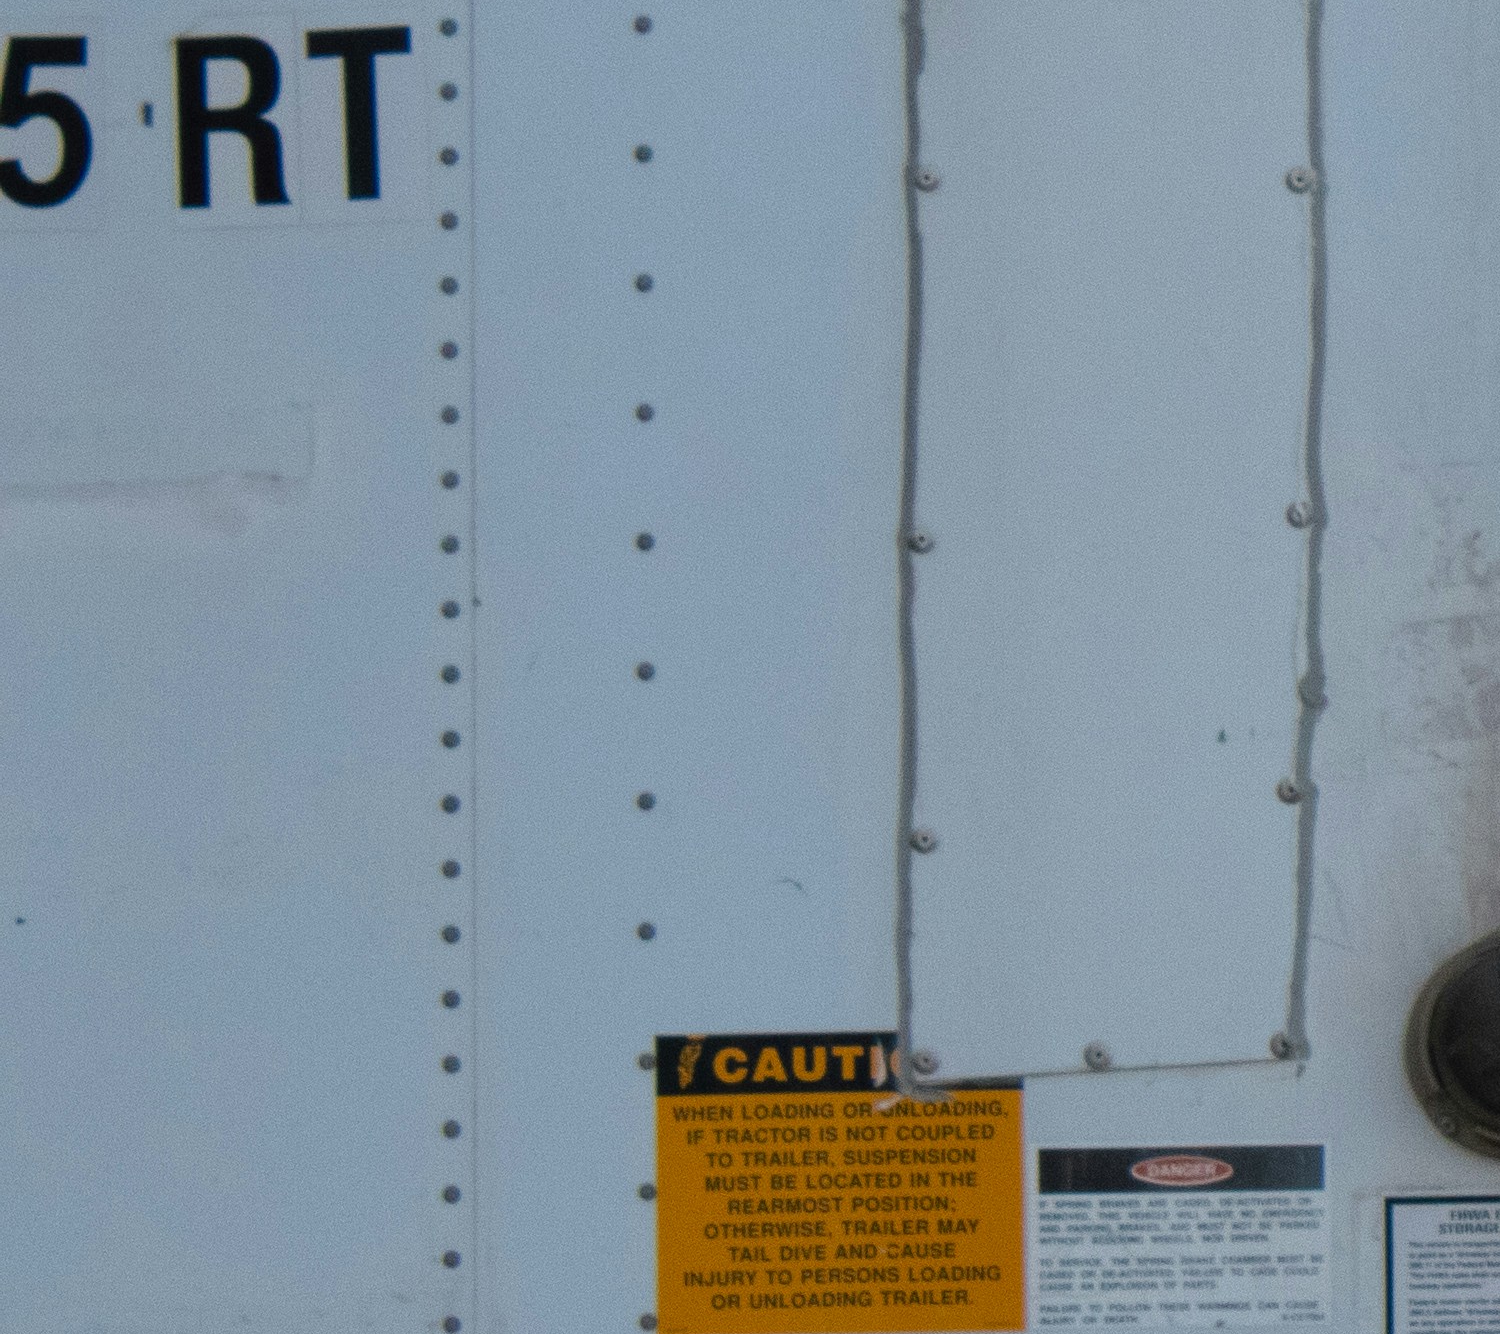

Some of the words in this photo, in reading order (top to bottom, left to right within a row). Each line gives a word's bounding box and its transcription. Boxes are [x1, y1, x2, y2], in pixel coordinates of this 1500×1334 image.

[0, 34, 93, 208] 5
[173, 25, 412, 209] RT
[712, 1045, 901, 1084] CAUTI
[673, 1105, 734, 1122] WHEN
[742, 1103, 834, 1120] LOADING
[843, 1102, 873, 1118] OR
[687, 1129, 704, 1145] IF
[714, 1127, 811, 1144] TRACTOR
[820, 1127, 838, 1142] IS
[846, 1125, 888, 1141] NOT
[896, 1124, 995, 1140] COUPLED
[706, 1152, 733, 1167] TO
[742, 1150, 834, 1167] TRAILER,
[843, 1148, 977, 1165] SUSPENSION
[705, 1176, 760, 1192] MUST
[771, 1175, 796, 1190] BE
[806, 1173, 901, 1189] LOCATED
[910, 1172, 930, 1187] IN
[939, 1172, 978, 1187] THE
[728, 1198, 842, 1215] REARMOST
[704, 1222, 832, 1239] OTHERWISE,
[842, 1220, 929, 1236] TRAILER
[938, 1219, 979, 1235] MAY
[729, 1247, 770, 1262] TAIL
[780, 1245, 827, 1261] DIVE
[835, 1244, 877, 1260] AND
[887, 1243, 956, 1259] CAUSE
[684, 1271, 758, 1286] INJURY
[766, 1269, 792, 1285] TO
[801, 1268, 899, 1285] PERSONS
[909, 1266, 1001, 1283] LOADING
[711, 1294, 742, 1310] OR
[752, 1292, 872, 1309] UNLOADING
